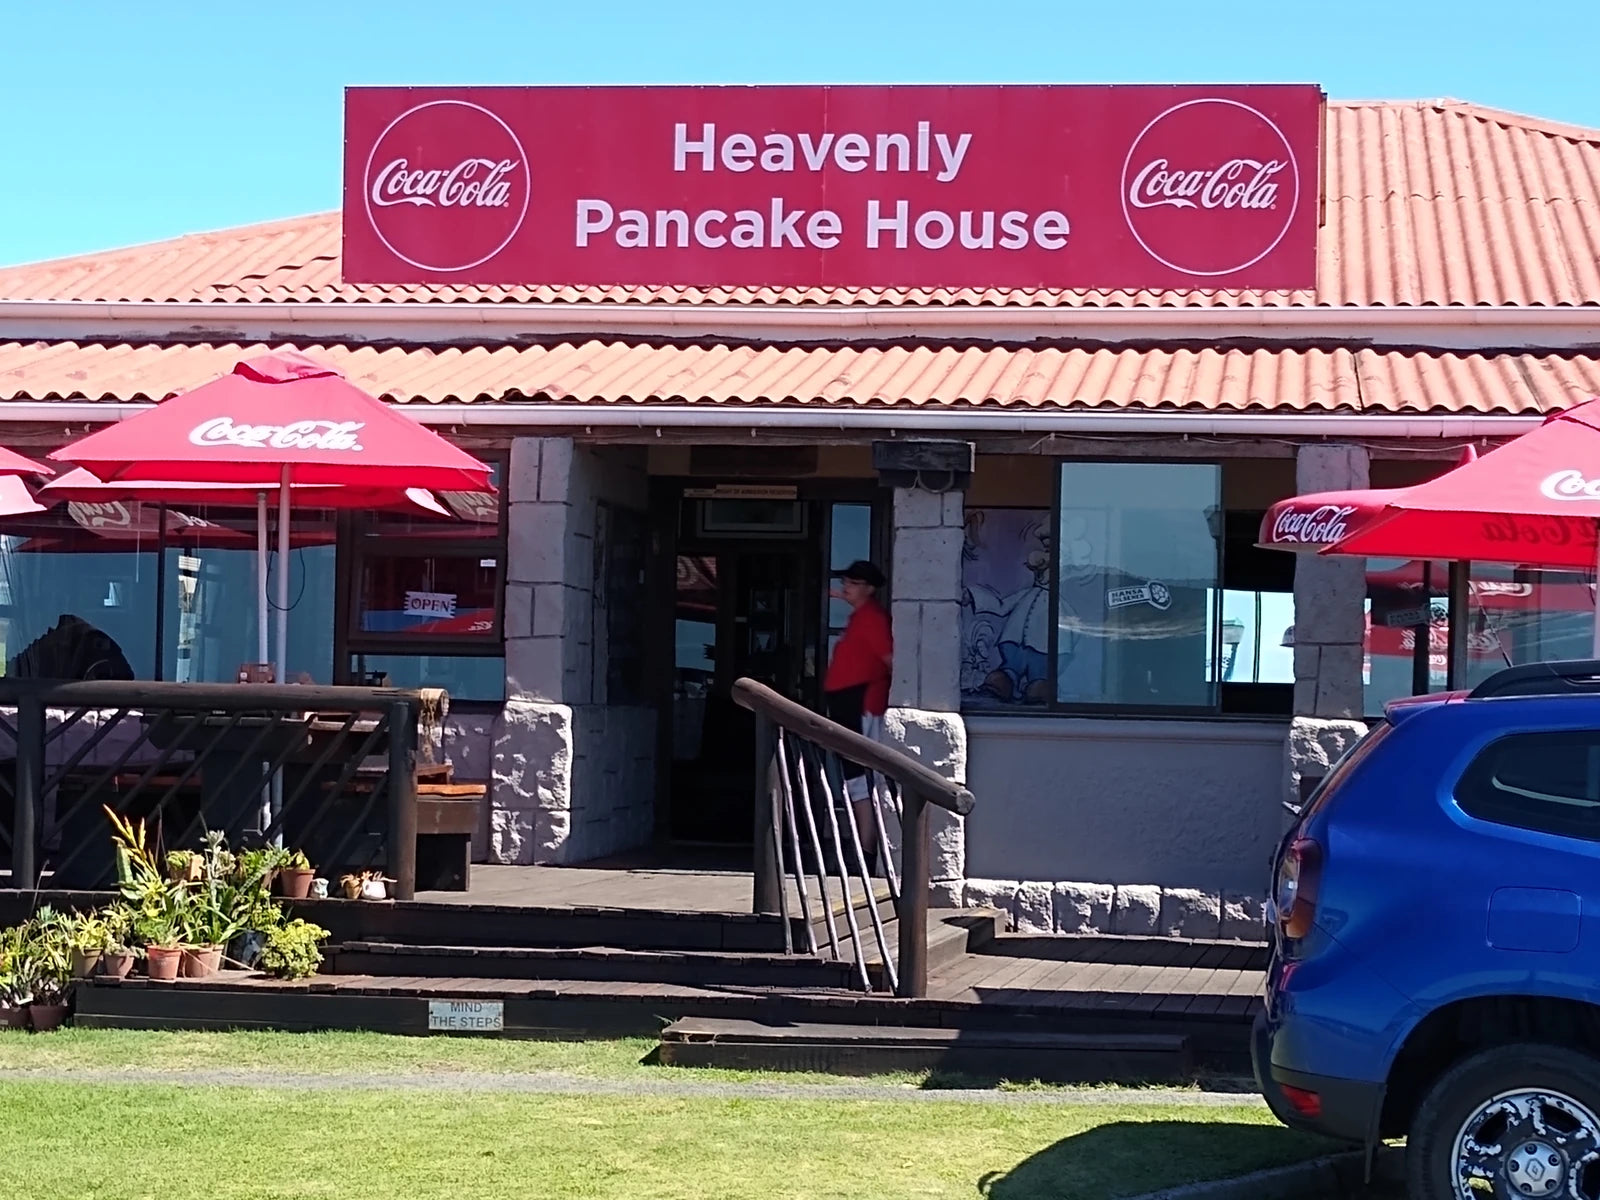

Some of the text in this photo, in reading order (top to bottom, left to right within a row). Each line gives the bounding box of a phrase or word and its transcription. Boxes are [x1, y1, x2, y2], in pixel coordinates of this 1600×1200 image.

[674, 121, 972, 182] Heavenly
[372, 158, 520, 207] Coca-Cola
[1130, 158, 1288, 209] Coca-Cola
[576, 198, 1070, 250] Pancake House
[410, 597, 451, 613] OPEN
[1111, 588, 1143, 598] HANSA
[431, 1016, 502, 1028] THE STEPS
[450, 1002, 482, 1013] MIND
